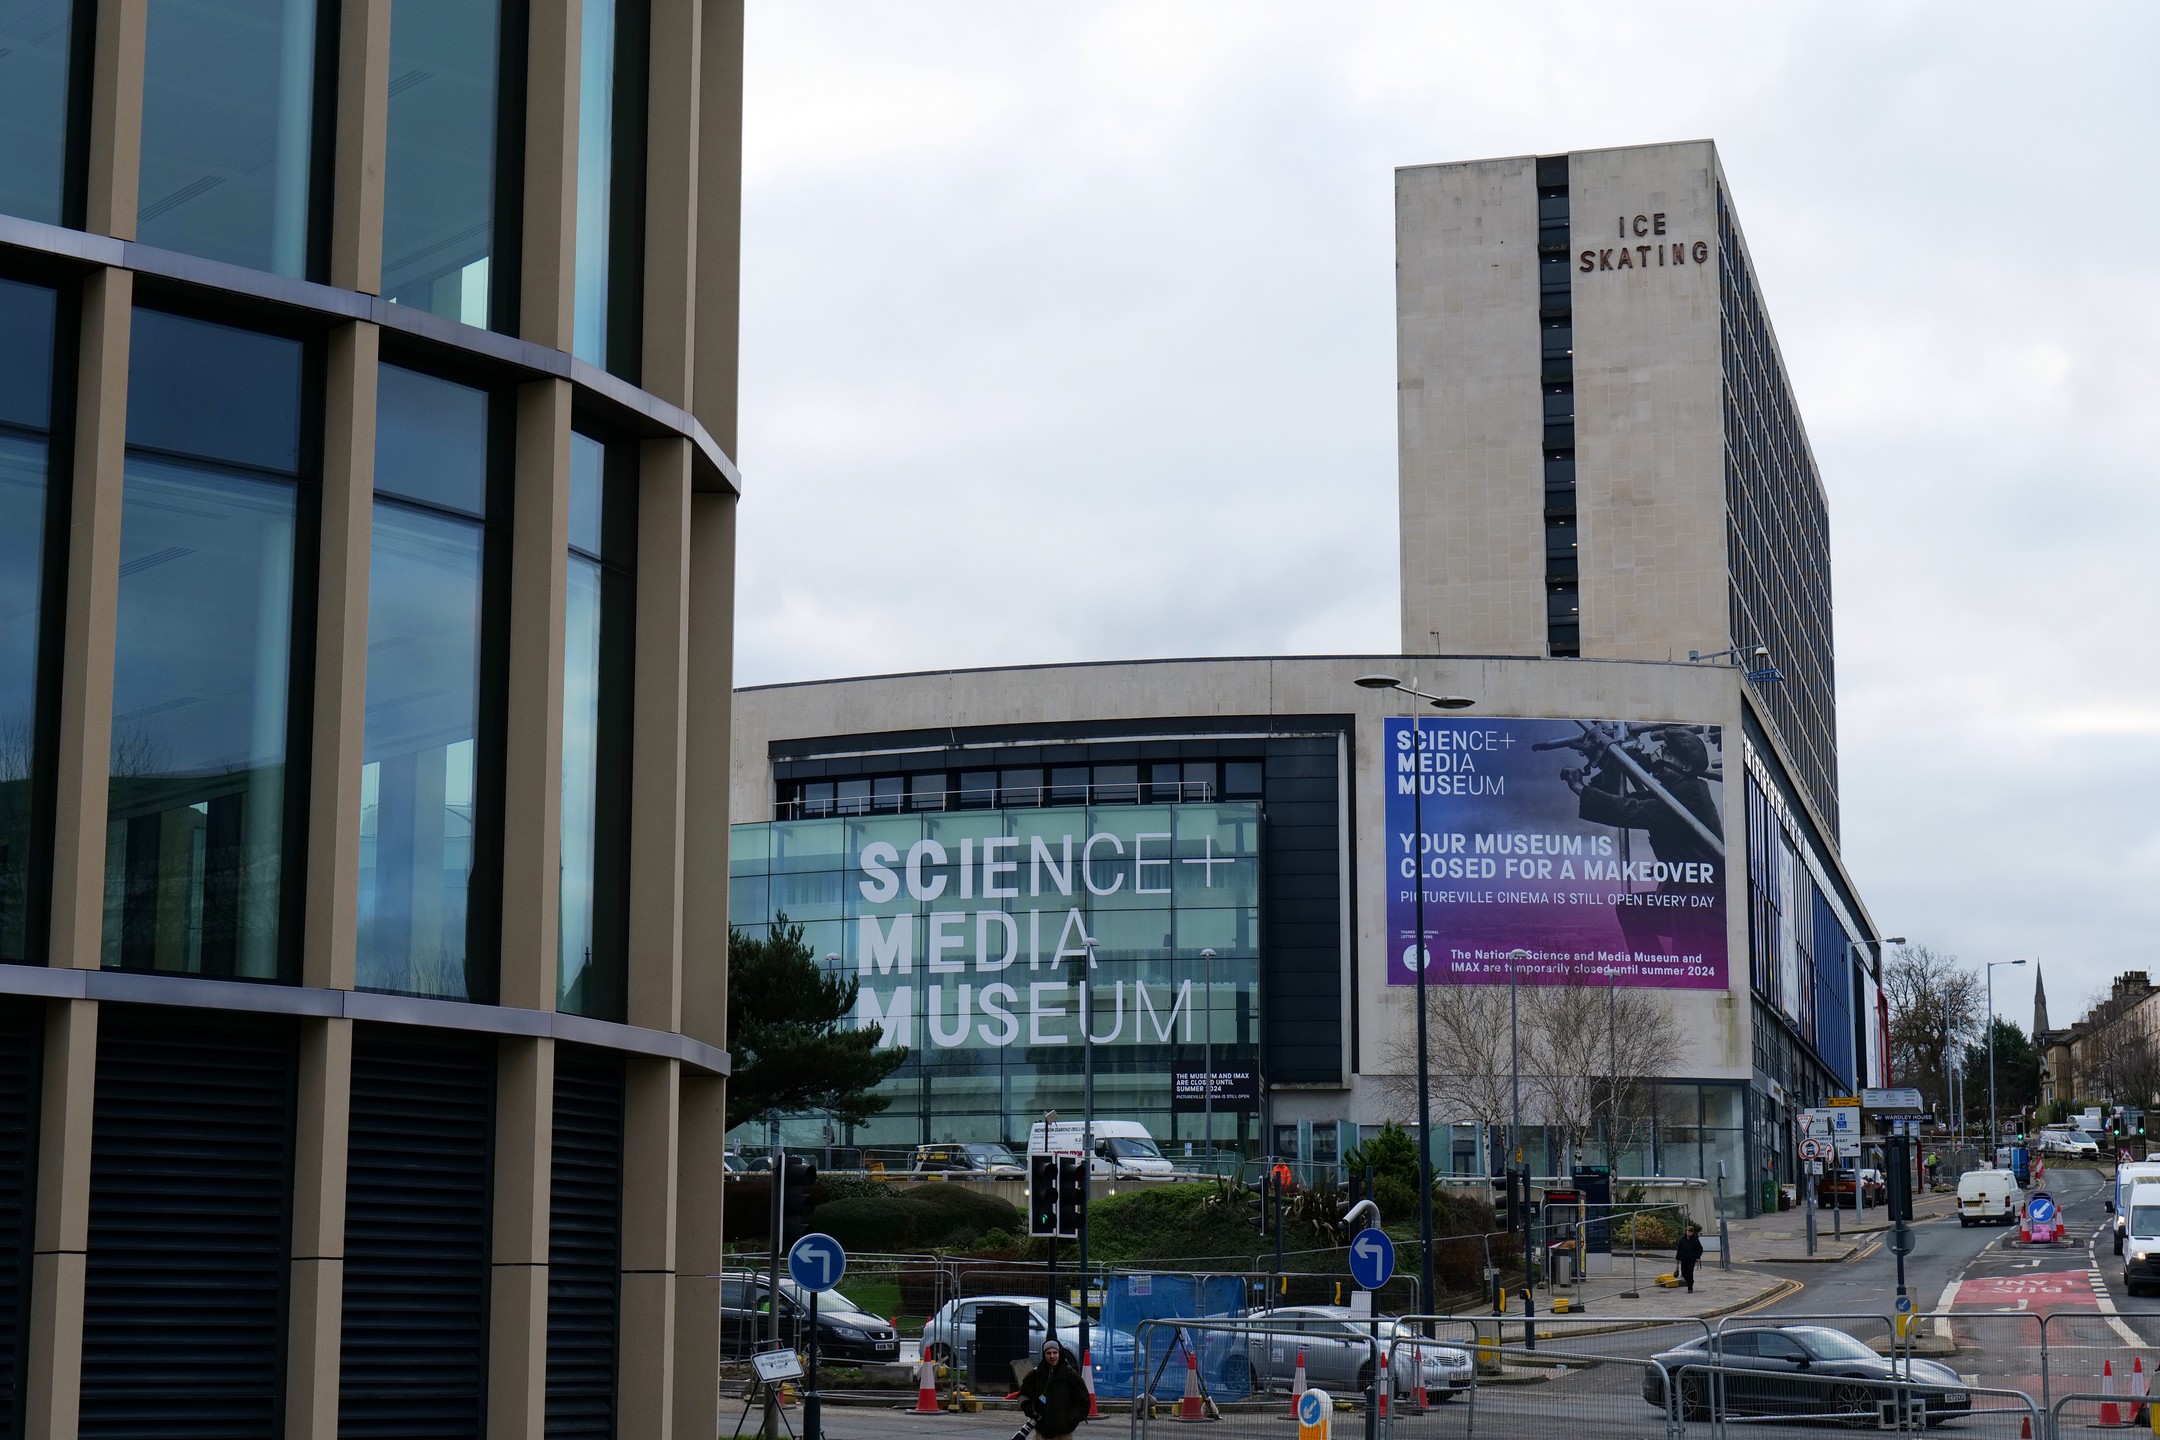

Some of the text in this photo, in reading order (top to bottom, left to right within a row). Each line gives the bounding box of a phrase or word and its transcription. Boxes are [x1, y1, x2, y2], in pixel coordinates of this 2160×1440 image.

[1619, 213, 1666, 238] ICE
[1579, 241, 1708, 273] SKATING
[1396, 730, 1516, 751] SCIENCE+
[1398, 752, 1475, 773] MEDIA
[1398, 774, 1505, 796] MUSEUM
[1399, 833, 1612, 856] YOUR MUSEUM IS
[858, 832, 1235, 904] SCIENCE+
[1505, 859, 1553, 880] FOR
[1559, 859, 1576, 880] A
[1584, 860, 1714, 884] MAKEOVER
[1497, 891, 1549, 904] CINEMA
[1553, 892, 1565, 905] IS
[1569, 892, 1604, 905] STILL
[1607, 893, 1643, 906] OPEN
[1646, 893, 1687, 907] EVERY
[1691, 895, 1715, 908] DAY
[858, 907, 1098, 977] MEDIA
[1451, 949, 1471, 960] The
[1526, 950, 1570, 960] Science
[1574, 951, 1594, 961] and
[1598, 951, 1631, 962] Media
[1634, 952, 1679, 963] Museum
[1682, 953, 1702, 964] and
[1451, 962, 1480, 972] IMAX
[1483, 964, 1501, 972] are
[1574, 964, 1610, 974] closed
[1642, 966, 1684, 976] summer
[1688, 966, 1715, 976] 2024
[858, 979, 1192, 1049] MUSEUM
